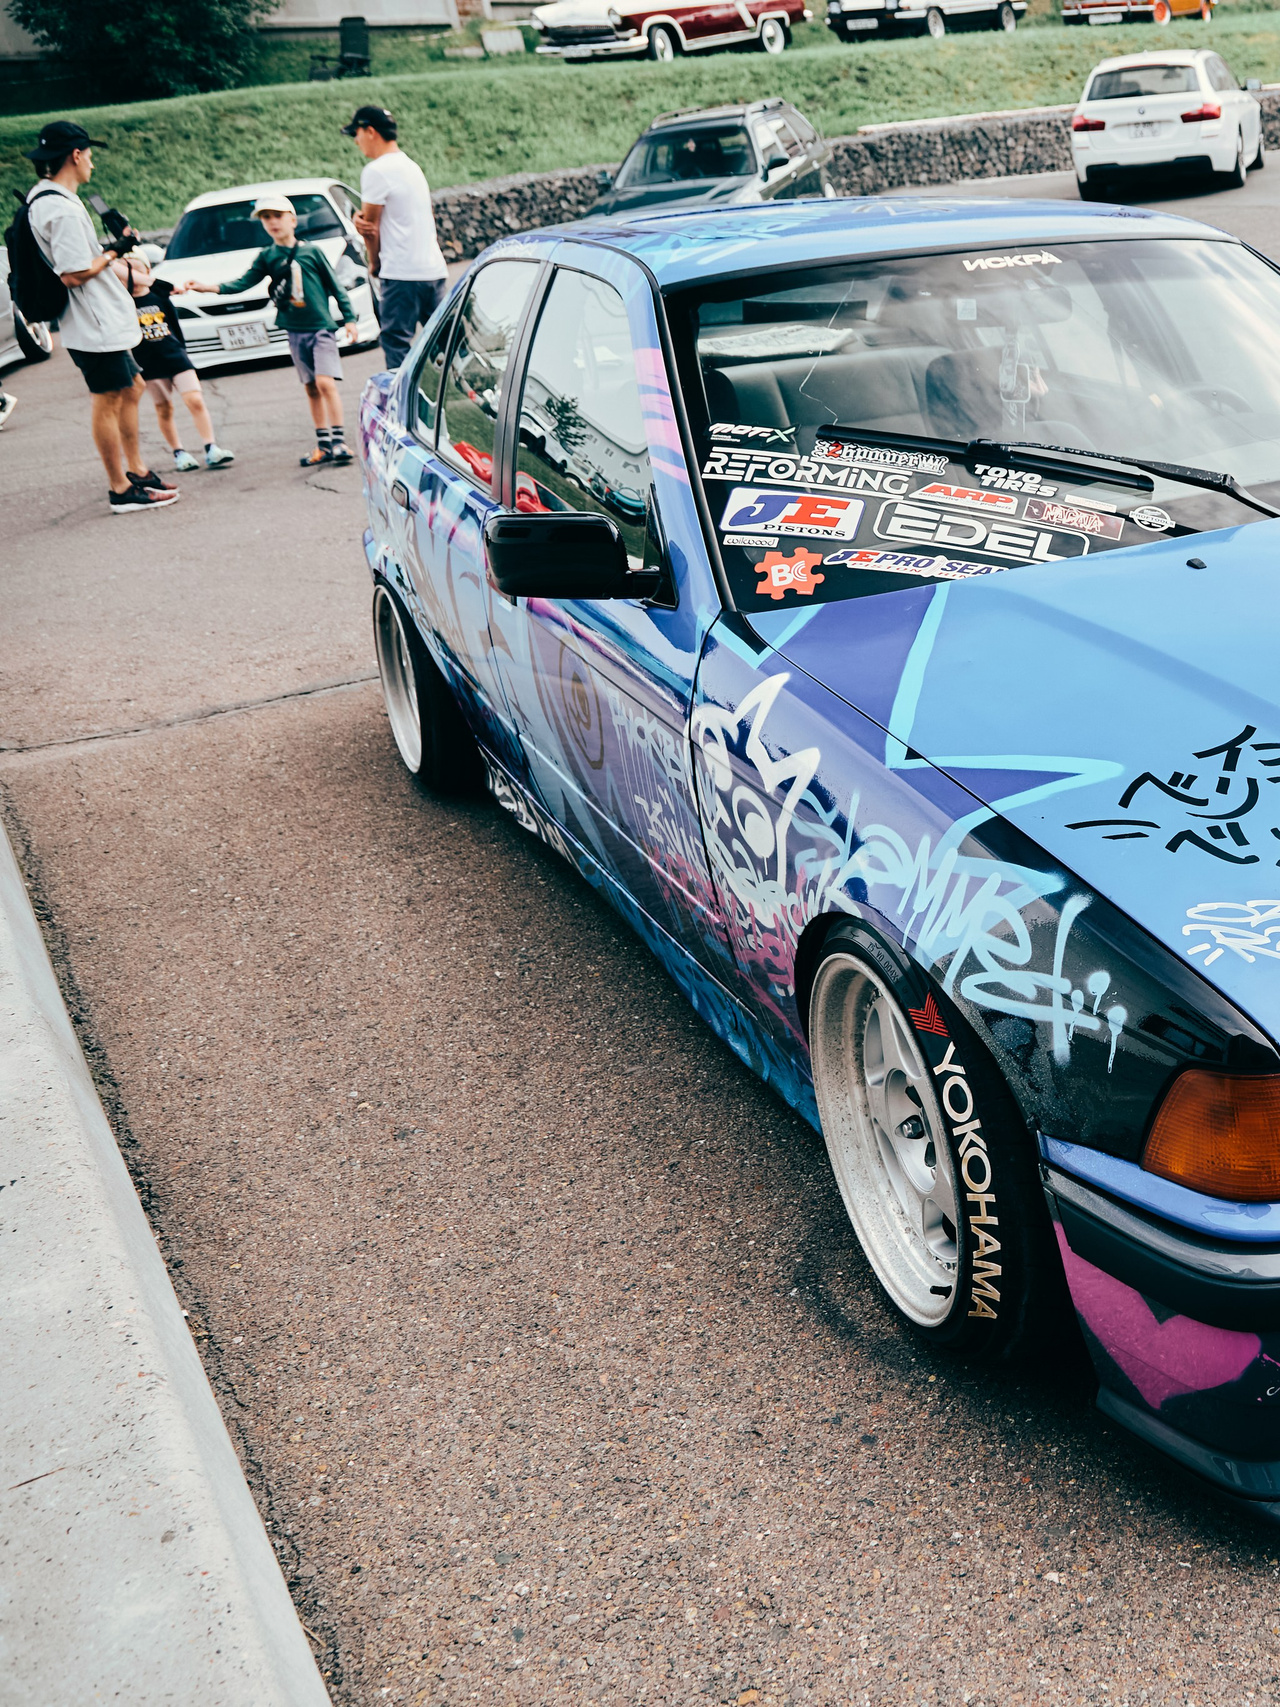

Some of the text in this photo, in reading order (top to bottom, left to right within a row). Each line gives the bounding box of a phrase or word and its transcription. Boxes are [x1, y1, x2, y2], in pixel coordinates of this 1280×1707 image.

[962, 250, 1063, 272] ИСКРА
[974, 464, 1042, 484] TOYO
[922, 484, 1013, 504] ARP
[981, 475, 1059, 497] TIRES
[729, 495, 851, 528] JE
[763, 524, 846, 538] PISTONS
[875, 553, 935, 569] PRO
[941, 562, 1005, 576] SEA
[932, 1041, 1002, 1320] YOKOHAMA
